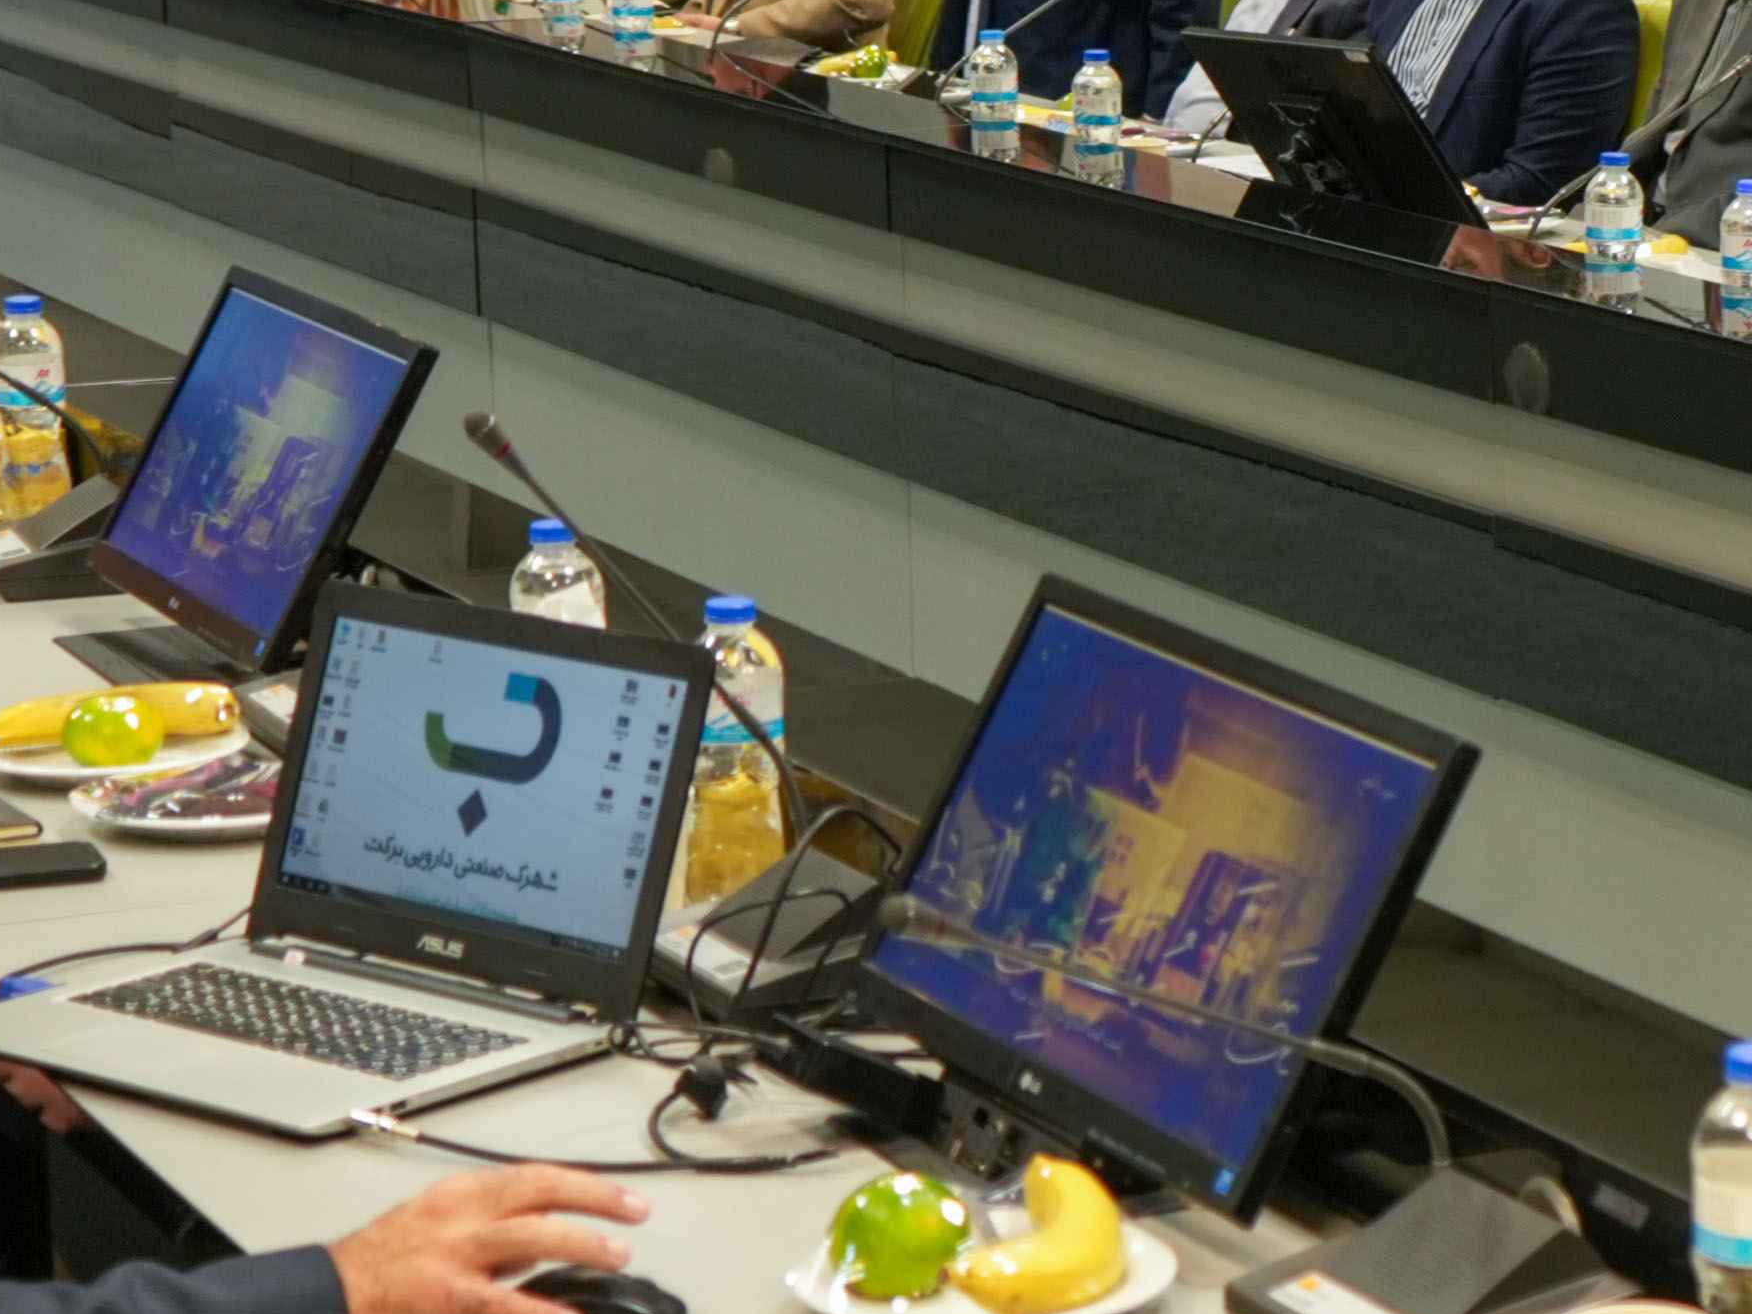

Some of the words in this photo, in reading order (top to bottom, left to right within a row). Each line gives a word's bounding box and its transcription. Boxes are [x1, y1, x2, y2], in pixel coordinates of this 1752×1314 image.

[363, 834, 404, 864] برکت
[403, 847, 453, 872] دارویی
[453, 856, 505, 880] صنعتی
[505, 863, 559, 892] شهرک
[415, 934, 466, 960] ASUS
